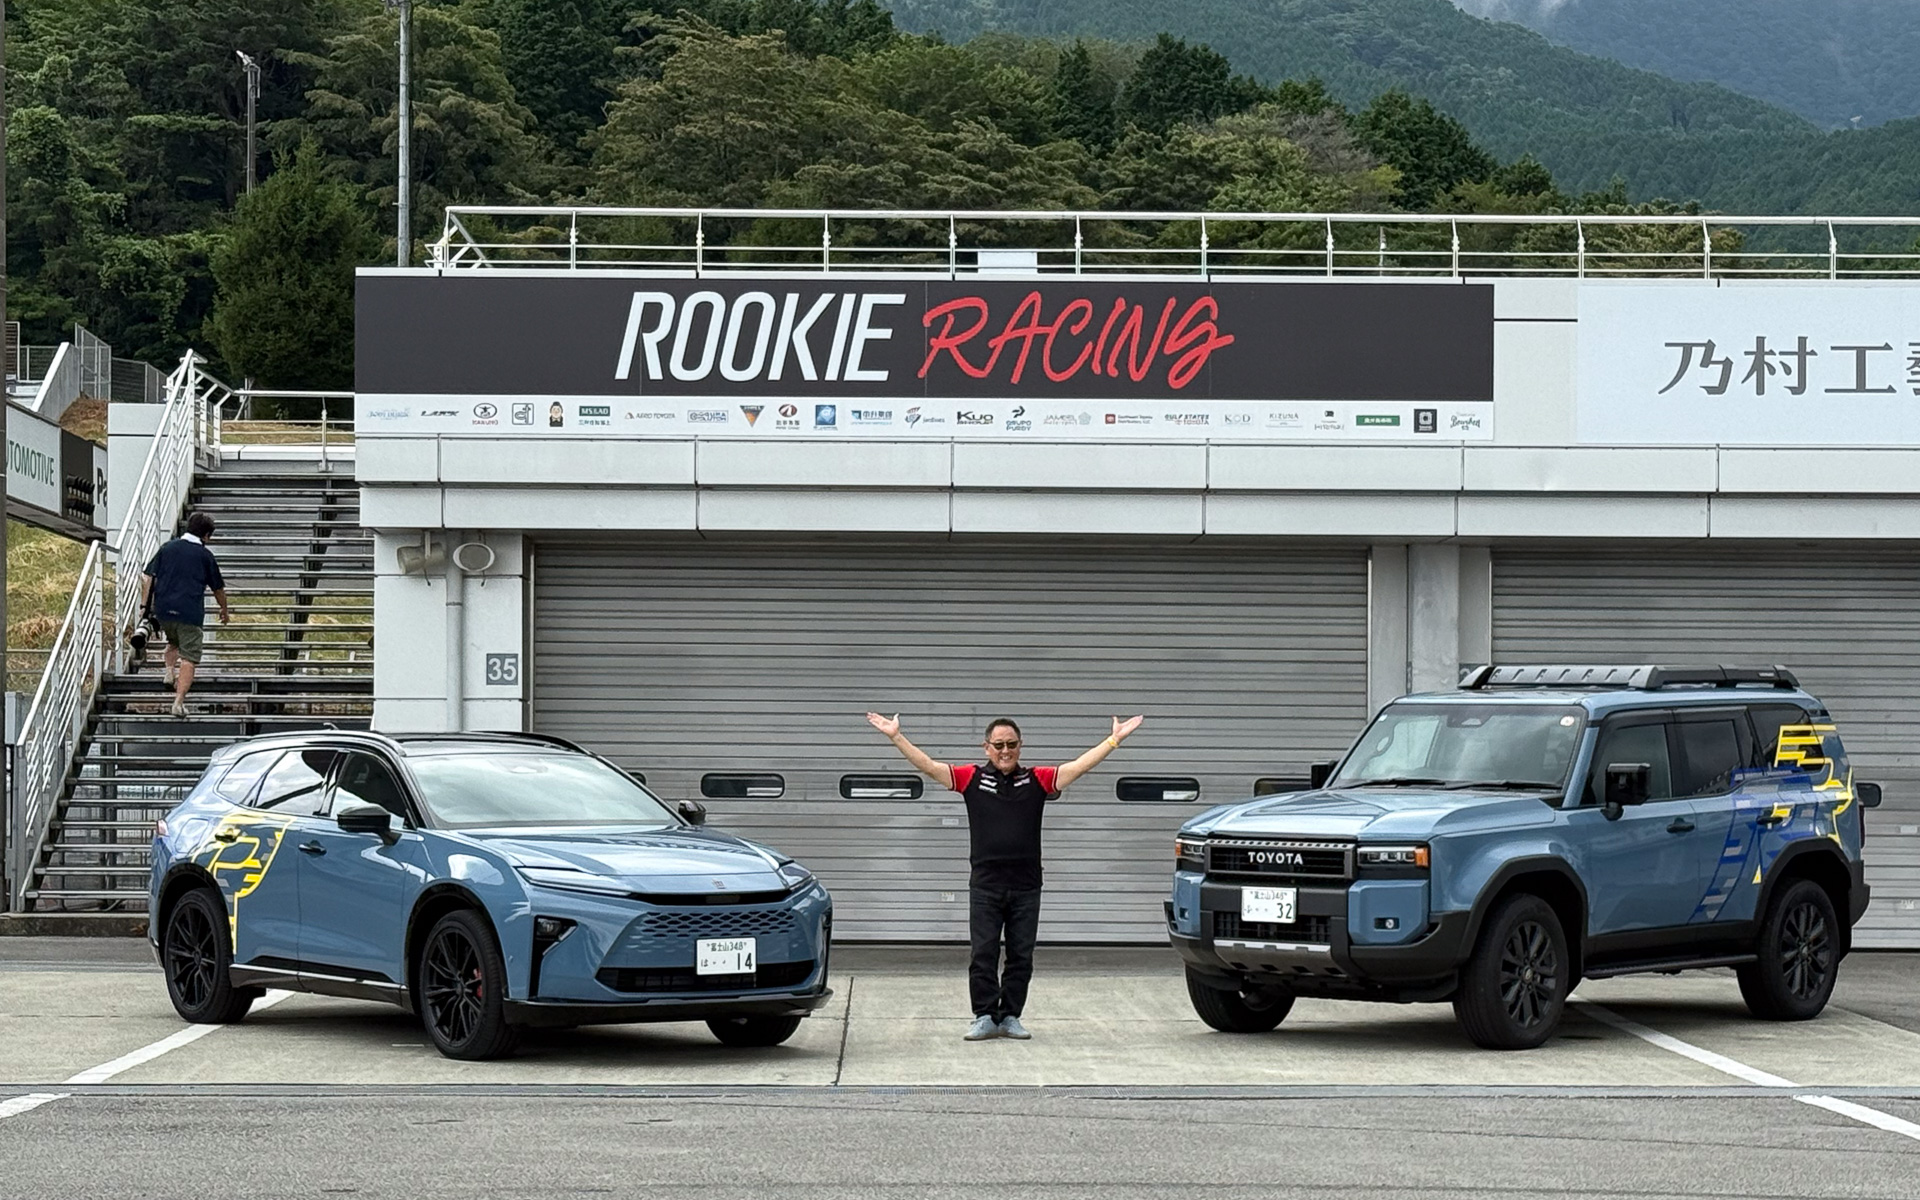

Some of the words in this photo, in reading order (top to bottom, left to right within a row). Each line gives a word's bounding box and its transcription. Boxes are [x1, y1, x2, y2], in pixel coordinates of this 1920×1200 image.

[614, 291, 906, 382] ROOKIE
[917, 290, 1235, 390] RACING
[1658, 336, 1920, 396] 乃村工
[488, 657, 517, 681] 35
[1247, 851, 1304, 865] TOYOTA
[1276, 902, 1293, 919] 32
[737, 952, 752, 970] 14
